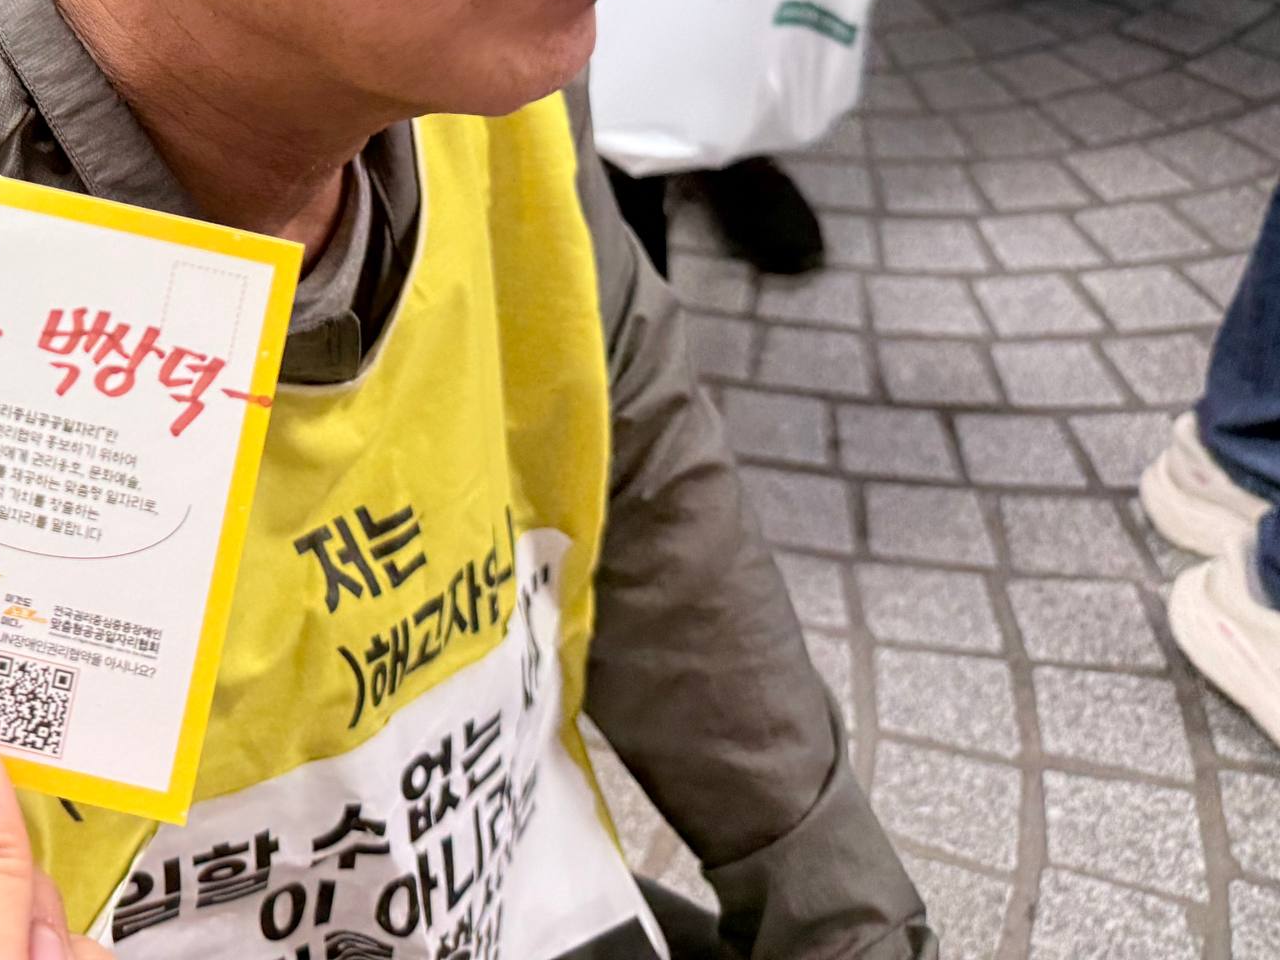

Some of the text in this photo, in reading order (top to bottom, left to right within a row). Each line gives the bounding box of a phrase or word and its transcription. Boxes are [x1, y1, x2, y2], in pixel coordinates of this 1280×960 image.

[293, 505, 429, 614] 저는
[104, 656, 157, 679] 아시나요?
[112, 710, 502, 942] 일할 수 없는
[260, 879, 337, 941] 이
